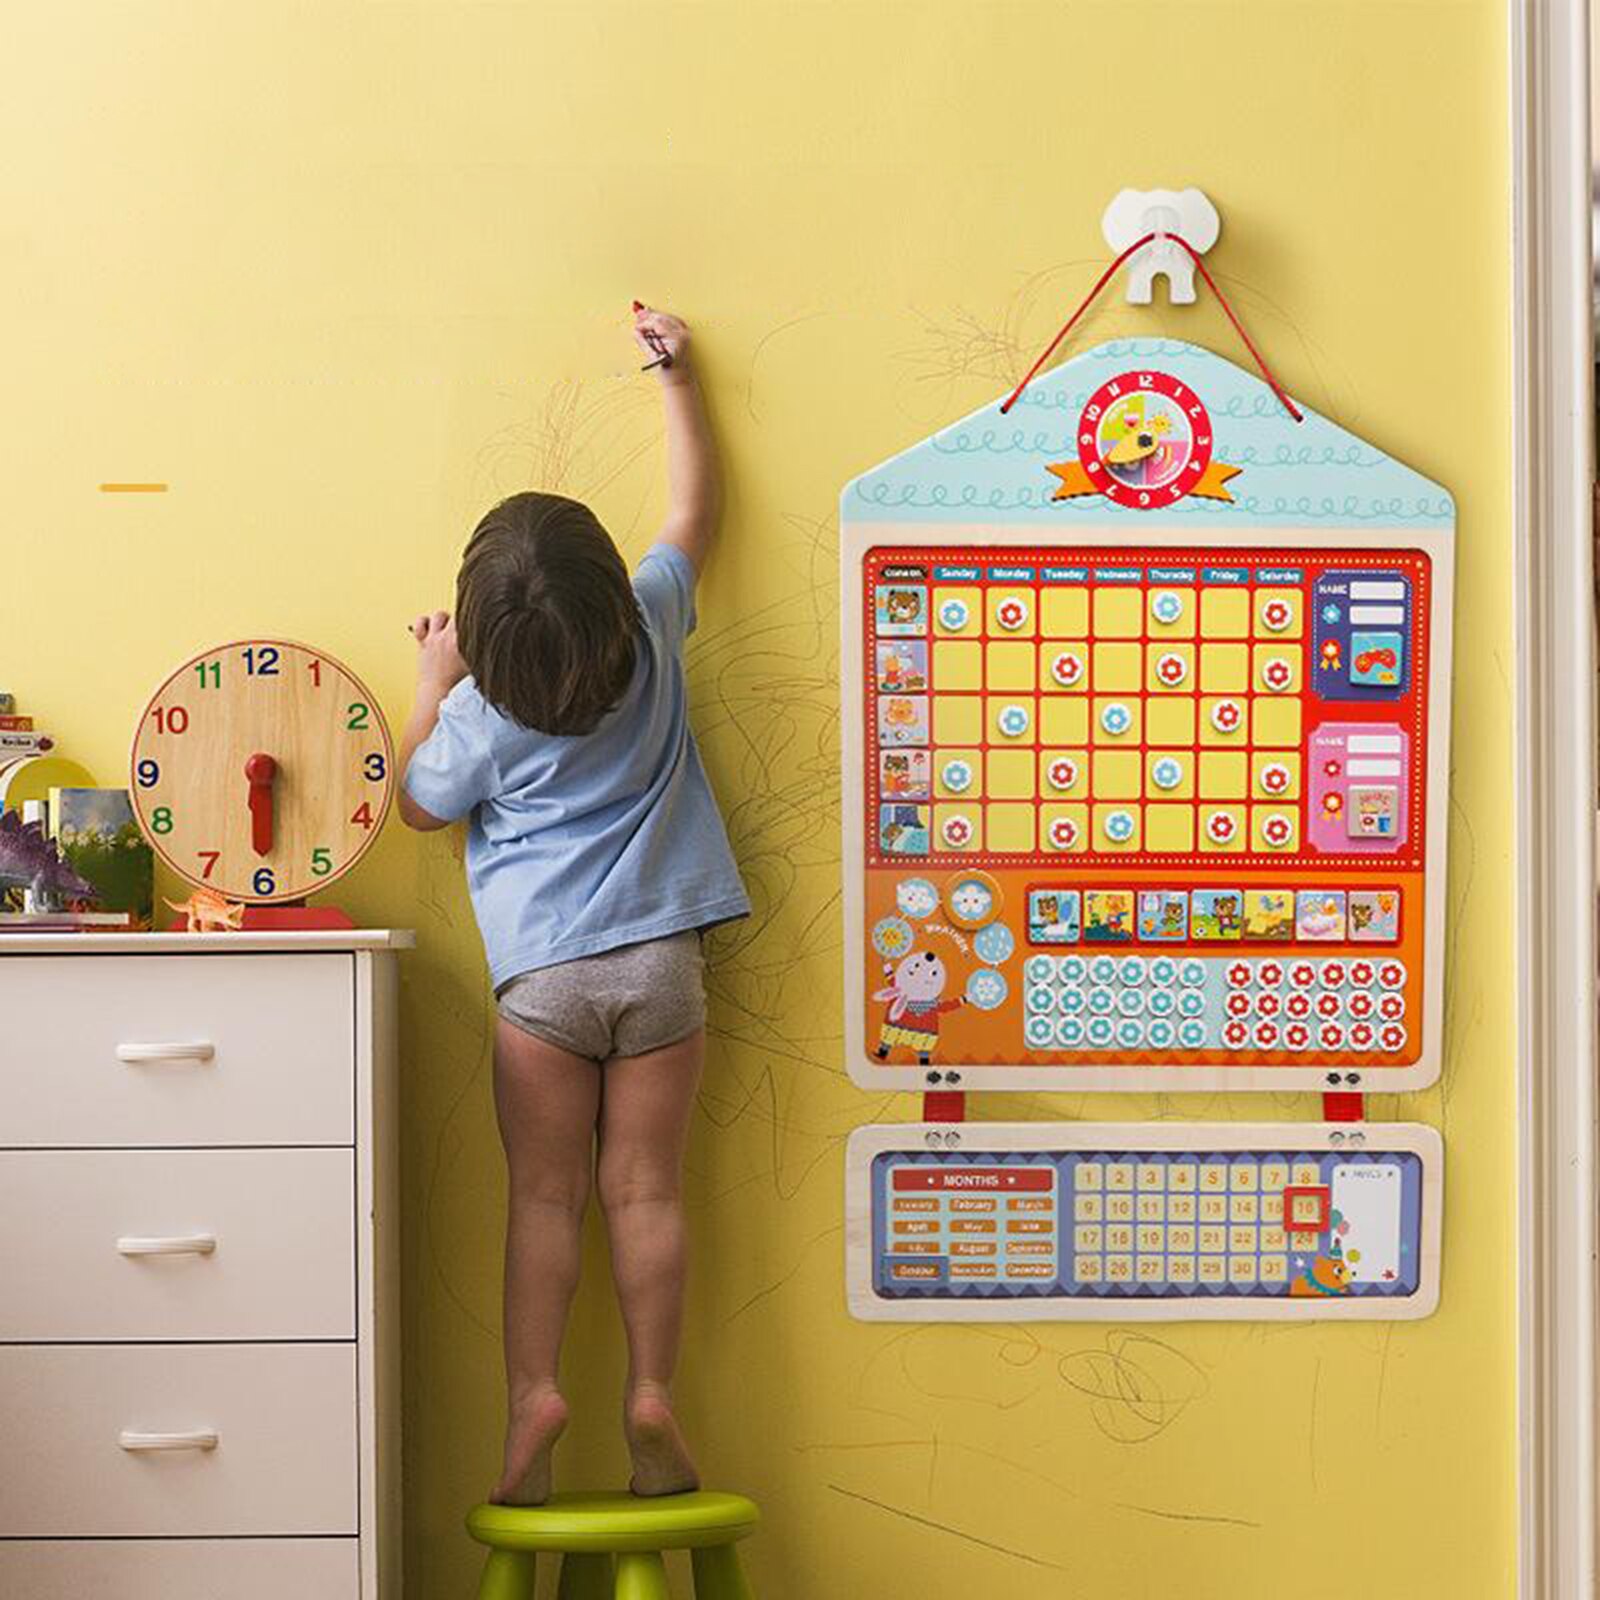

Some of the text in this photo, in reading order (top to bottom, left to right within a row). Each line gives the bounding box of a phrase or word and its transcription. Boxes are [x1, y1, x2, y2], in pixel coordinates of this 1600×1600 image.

[1139, 375, 1153, 387] 12
[1107, 383, 1120, 396] 11
[1174, 386, 1183, 397] 1
[1086, 404, 1101, 421] 10
[1189, 404, 1201, 418] 2
[1080, 433, 1093, 445] 9
[1197, 436, 1209, 445] 3
[1087, 462, 1100, 473] 8
[1188, 461, 1200, 472] 4
[1106, 485, 1119, 496] 7
[1170, 484, 1181, 496] 5
[1139, 493, 1150, 505] 6
[941, 568, 976, 579] Sunday
[993, 568, 1030, 579] Monday
[1045, 569, 1085, 580] Tuesday
[1151, 570, 1194, 580] Thursday
[1211, 570, 1239, 582] Friday
[1260, 571, 1300, 582] Saturday
[1319, 584, 1347, 594] NAME
[242, 647, 280, 676] 12
[195, 661, 221, 689] 11
[308, 660, 321, 687] 1
[152, 707, 189, 734] 10
[347, 703, 369, 730] 2
[137, 759, 160, 787] 9
[364, 753, 385, 781] 3
[151, 806, 173, 834] 8
[351, 802, 374, 829] 4
[197, 851, 220, 878] 7
[311, 848, 332, 875] 5
[253, 867, 275, 895] 6
[944, 1175, 999, 1186] MONTHS
[1086, 1170, 1311, 1185] 1 2 3 4 5 6 7 8
[953, 1199, 992, 1210] February
[1084, 1201, 1093, 1214] 9
[1112, 1201, 1128, 1215] 10
[1142, 1202, 1158, 1214] 11
[1174, 1202, 1190, 1214] 12
[1206, 1202, 1221, 1214] 13
[1236, 1202, 1251, 1214] 14
[1083, 1231, 1098, 1244] 17
[1142, 1232, 1159, 1244] 19
[1173, 1232, 1189, 1244] 20
[1203, 1232, 1219, 1243] 21
[1235, 1232, 1251, 1243] 22
[959, 1244, 990, 1254] August
[1081, 1262, 1098, 1275] 25
[1111, 1262, 1128, 1275] 26
[1141, 1262, 1158, 1274] 27
[1203, 1262, 1221, 1273] 29
[1234, 1262, 1251, 1274] 30
[1265, 1262, 1280, 1274] 31
